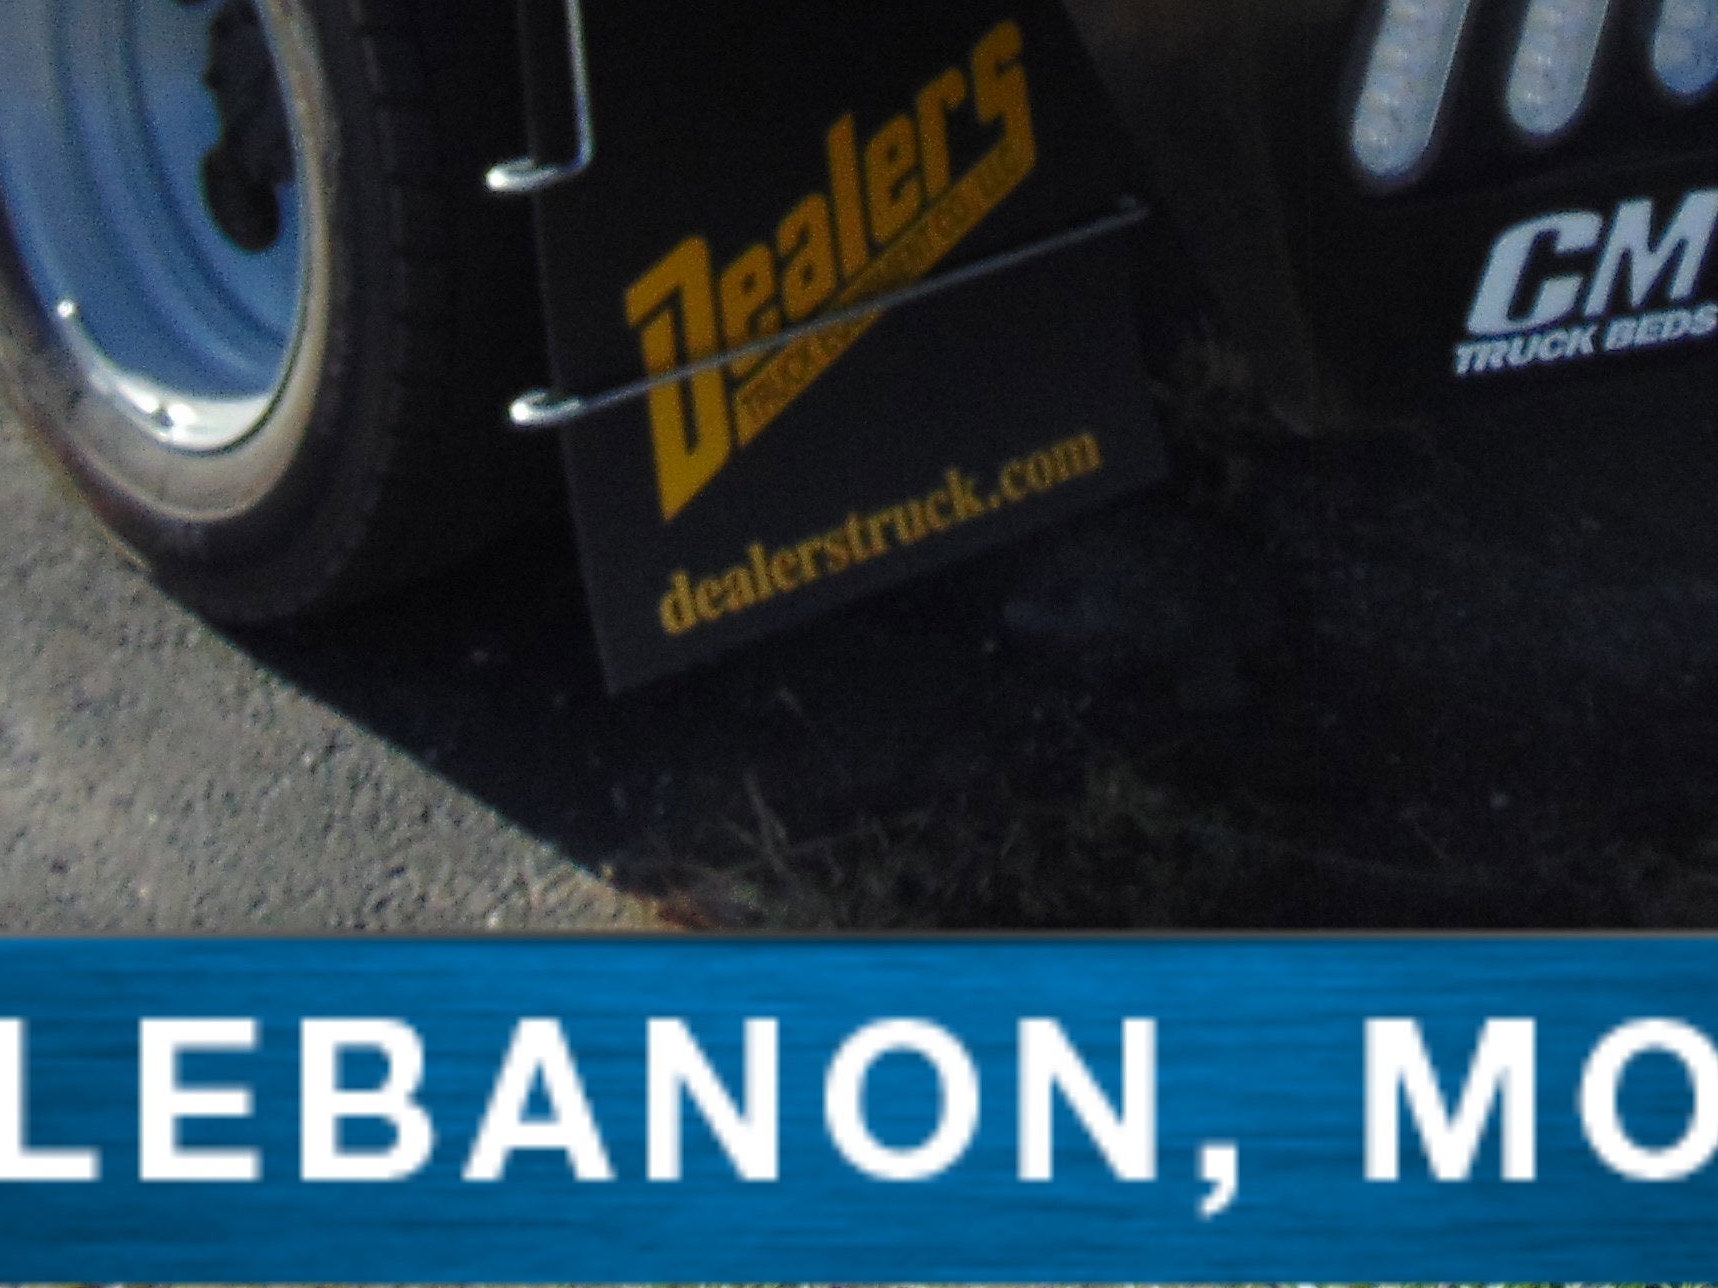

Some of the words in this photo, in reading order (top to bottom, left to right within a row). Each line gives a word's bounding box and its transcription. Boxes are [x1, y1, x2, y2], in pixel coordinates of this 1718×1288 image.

[625, 18, 1036, 521] Dealers
[1455, 325, 1598, 375] TRUCK
[659, 431, 1102, 634] dealerstruck.com
